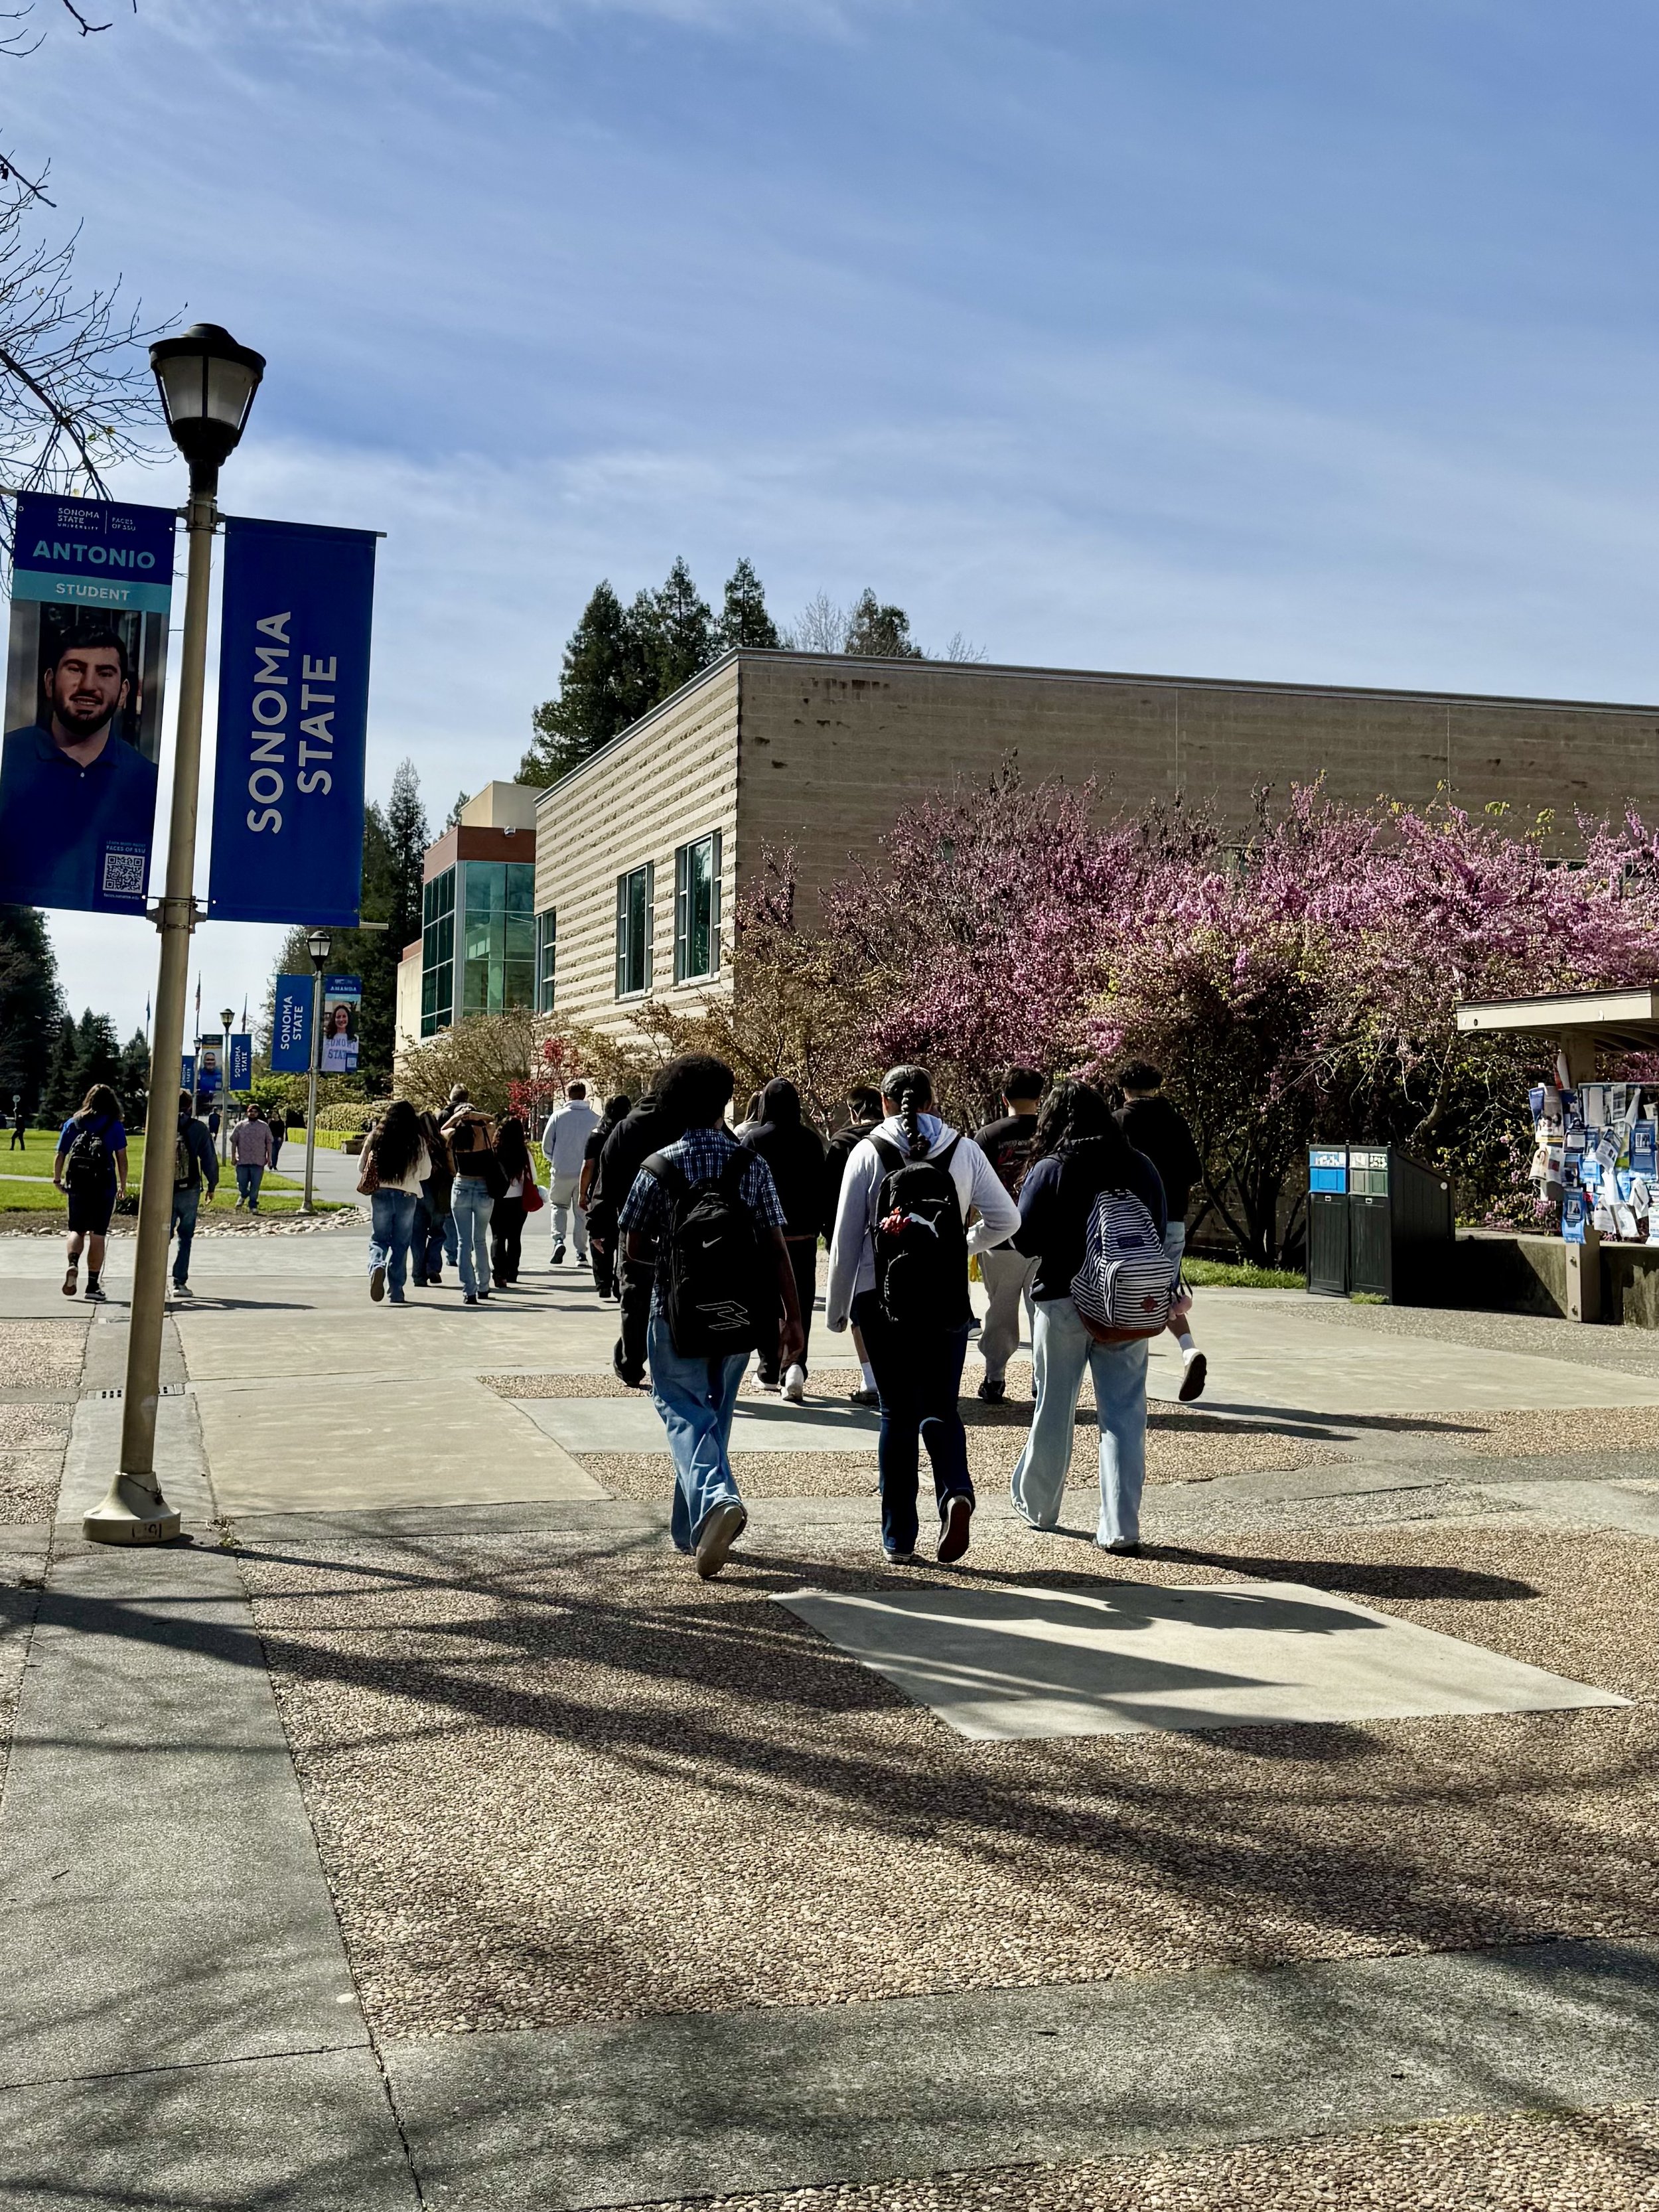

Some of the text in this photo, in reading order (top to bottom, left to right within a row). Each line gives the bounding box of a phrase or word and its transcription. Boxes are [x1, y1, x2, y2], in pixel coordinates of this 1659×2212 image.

[58, 508, 100, 518] SONOMA
[58, 515, 84, 524] STATE
[33, 540, 155, 569] ANTONIO
[56, 583, 131, 601] STUDENT
[247, 611, 291, 834] SONOMA
[297, 654, 337, 796] STATE
[281, 995, 293, 1050] SONOMA
[293, 1005, 303, 1041] STATE
